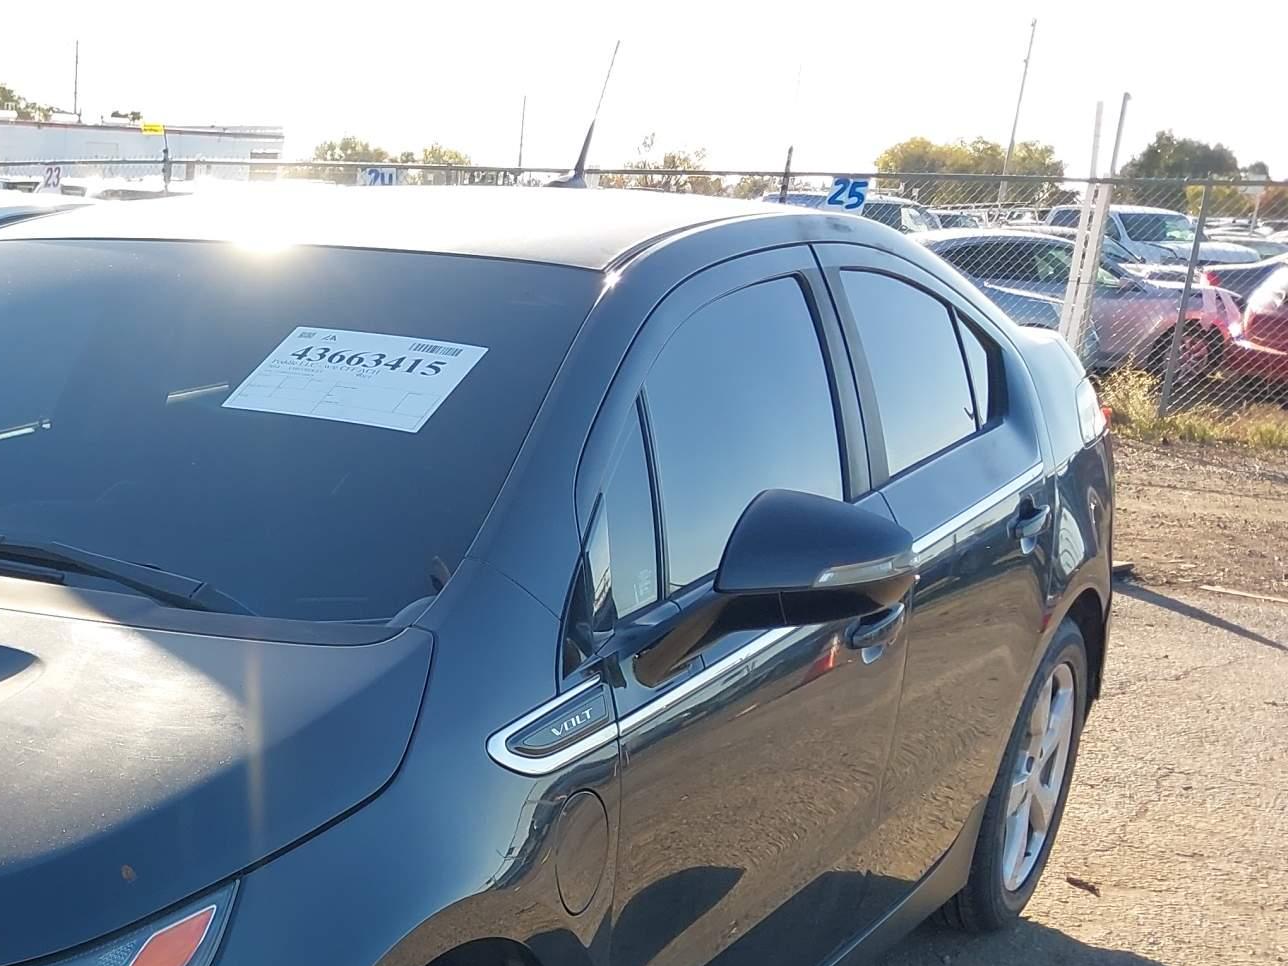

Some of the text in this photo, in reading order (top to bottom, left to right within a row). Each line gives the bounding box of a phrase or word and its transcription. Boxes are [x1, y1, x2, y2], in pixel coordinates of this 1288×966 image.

[44, 166, 61, 188] 23
[828, 178, 868, 209] 25
[291, 345, 447, 376] 43663415
[551, 707, 593, 736] VOLT
